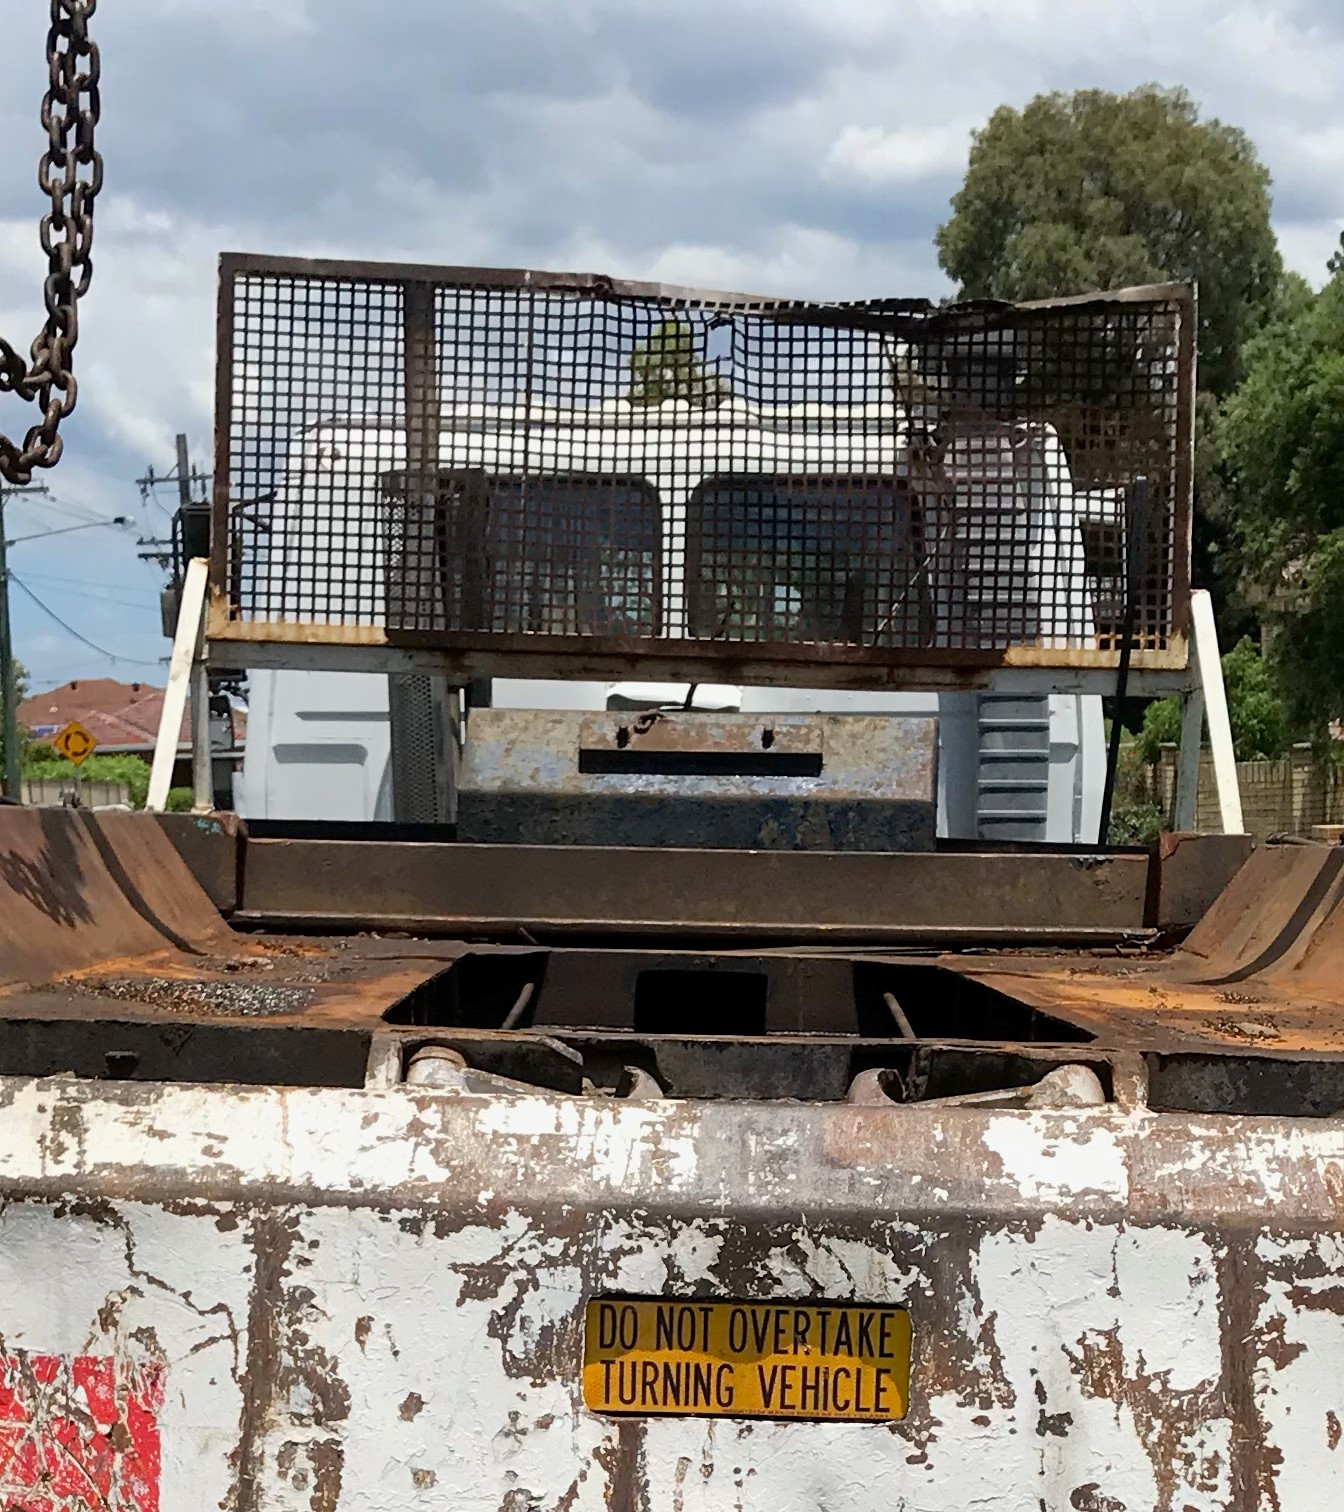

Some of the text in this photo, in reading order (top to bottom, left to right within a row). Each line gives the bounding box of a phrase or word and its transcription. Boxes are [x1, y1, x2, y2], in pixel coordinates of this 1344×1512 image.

[599, 1303, 896, 1359] DO NOT OVERTAKE
[600, 1359, 892, 1414] TURNING VEHICLE
